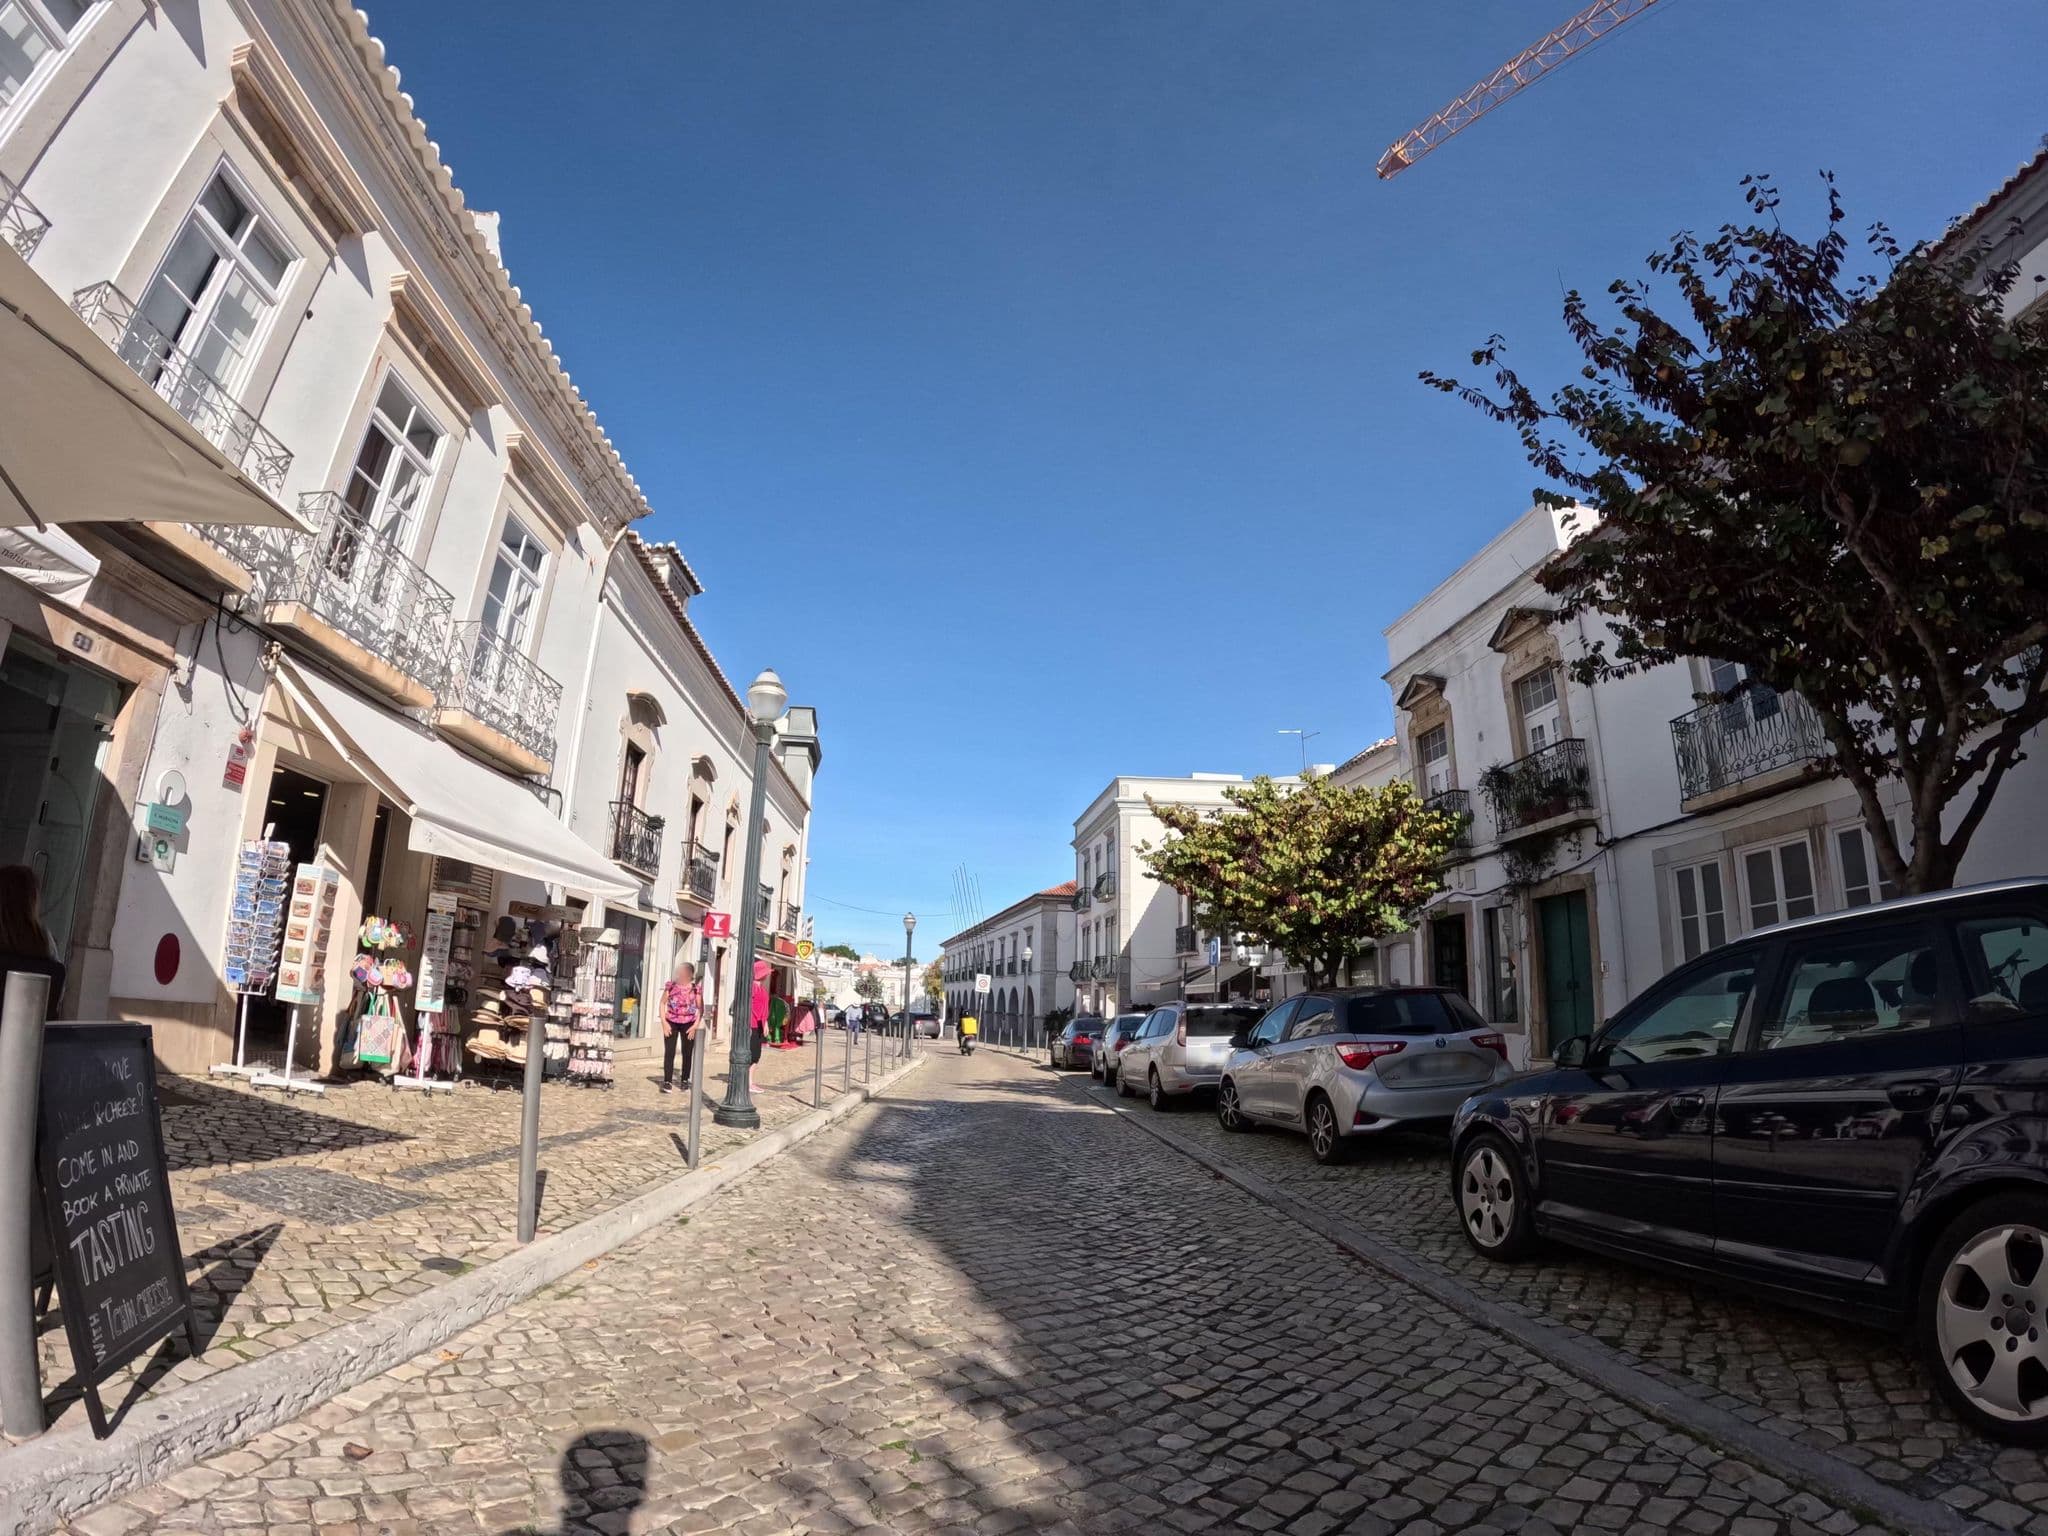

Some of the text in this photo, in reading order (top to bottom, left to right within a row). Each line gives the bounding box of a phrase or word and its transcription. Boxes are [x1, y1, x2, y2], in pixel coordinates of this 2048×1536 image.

[1210, 940, 1217, 964] P
[57, 1139, 139, 1188] COME IN AND
[63, 1168, 151, 1226] BOOK A PRIVATE
